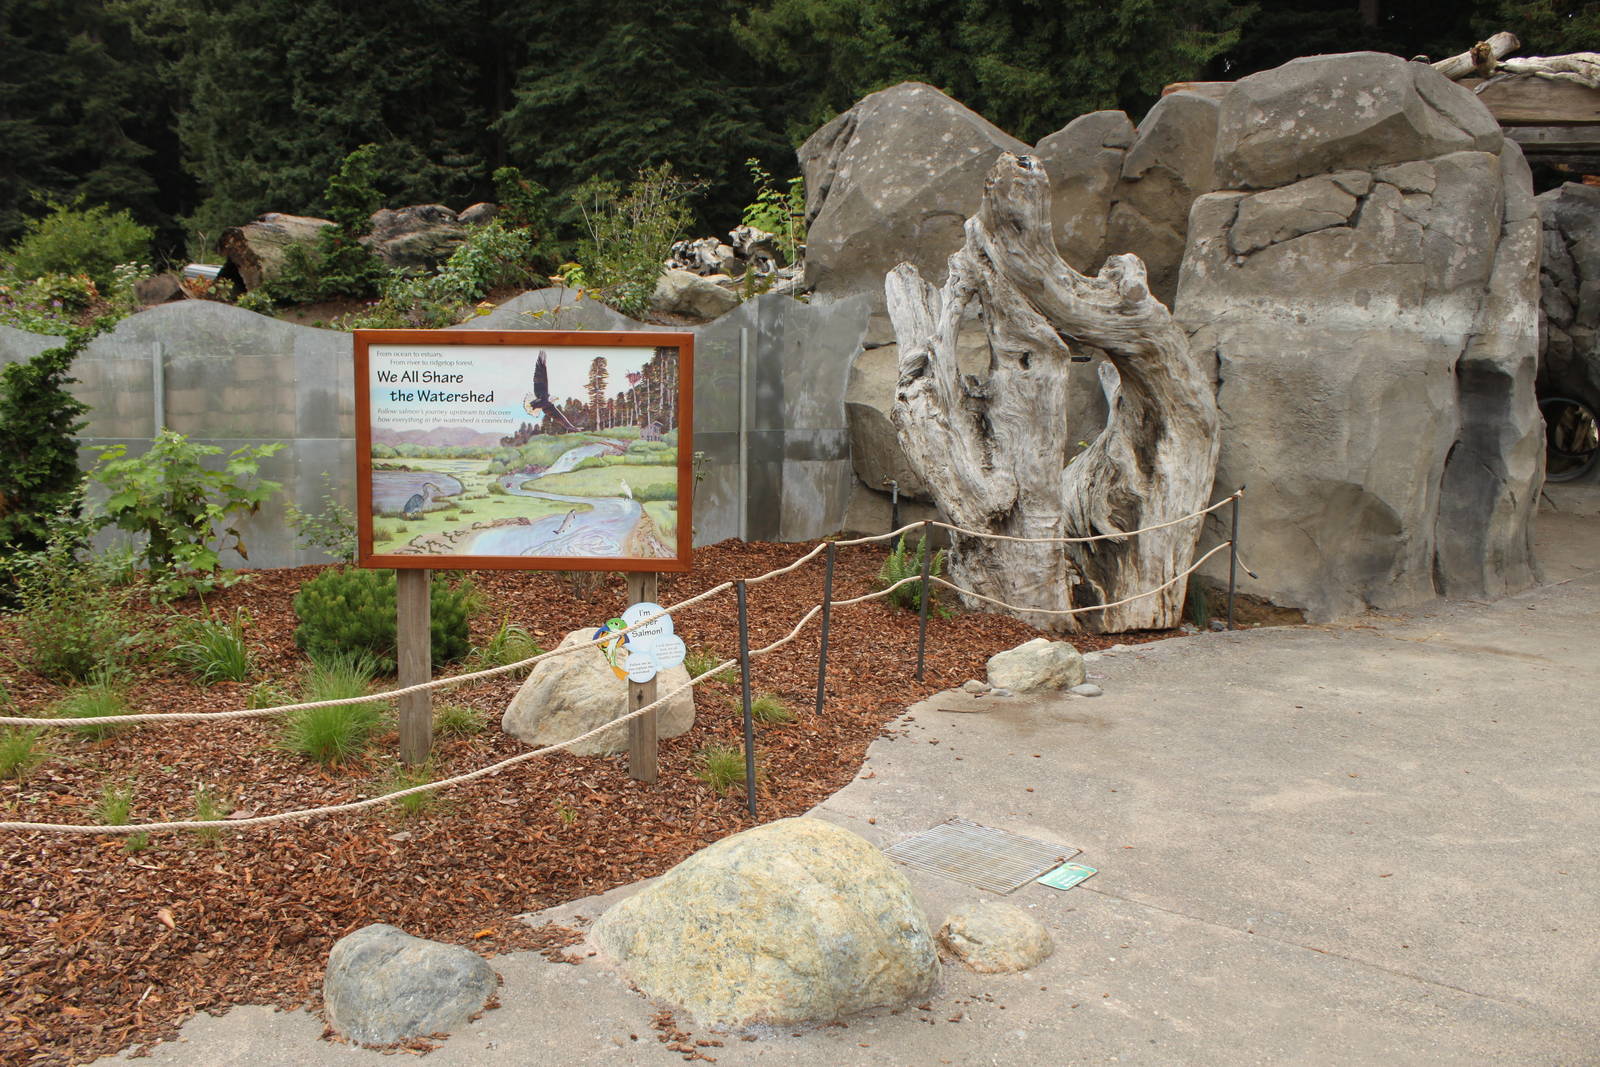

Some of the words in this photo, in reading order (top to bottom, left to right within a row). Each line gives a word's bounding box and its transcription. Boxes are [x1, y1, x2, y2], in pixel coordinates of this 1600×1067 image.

[377, 370, 398, 383] We
[401, 370, 419, 383] All
[422, 370, 464, 384] Share
[390, 389, 414, 402] the
[417, 389, 494, 402] Watershed
[632, 627, 663, 638] Salmon!
